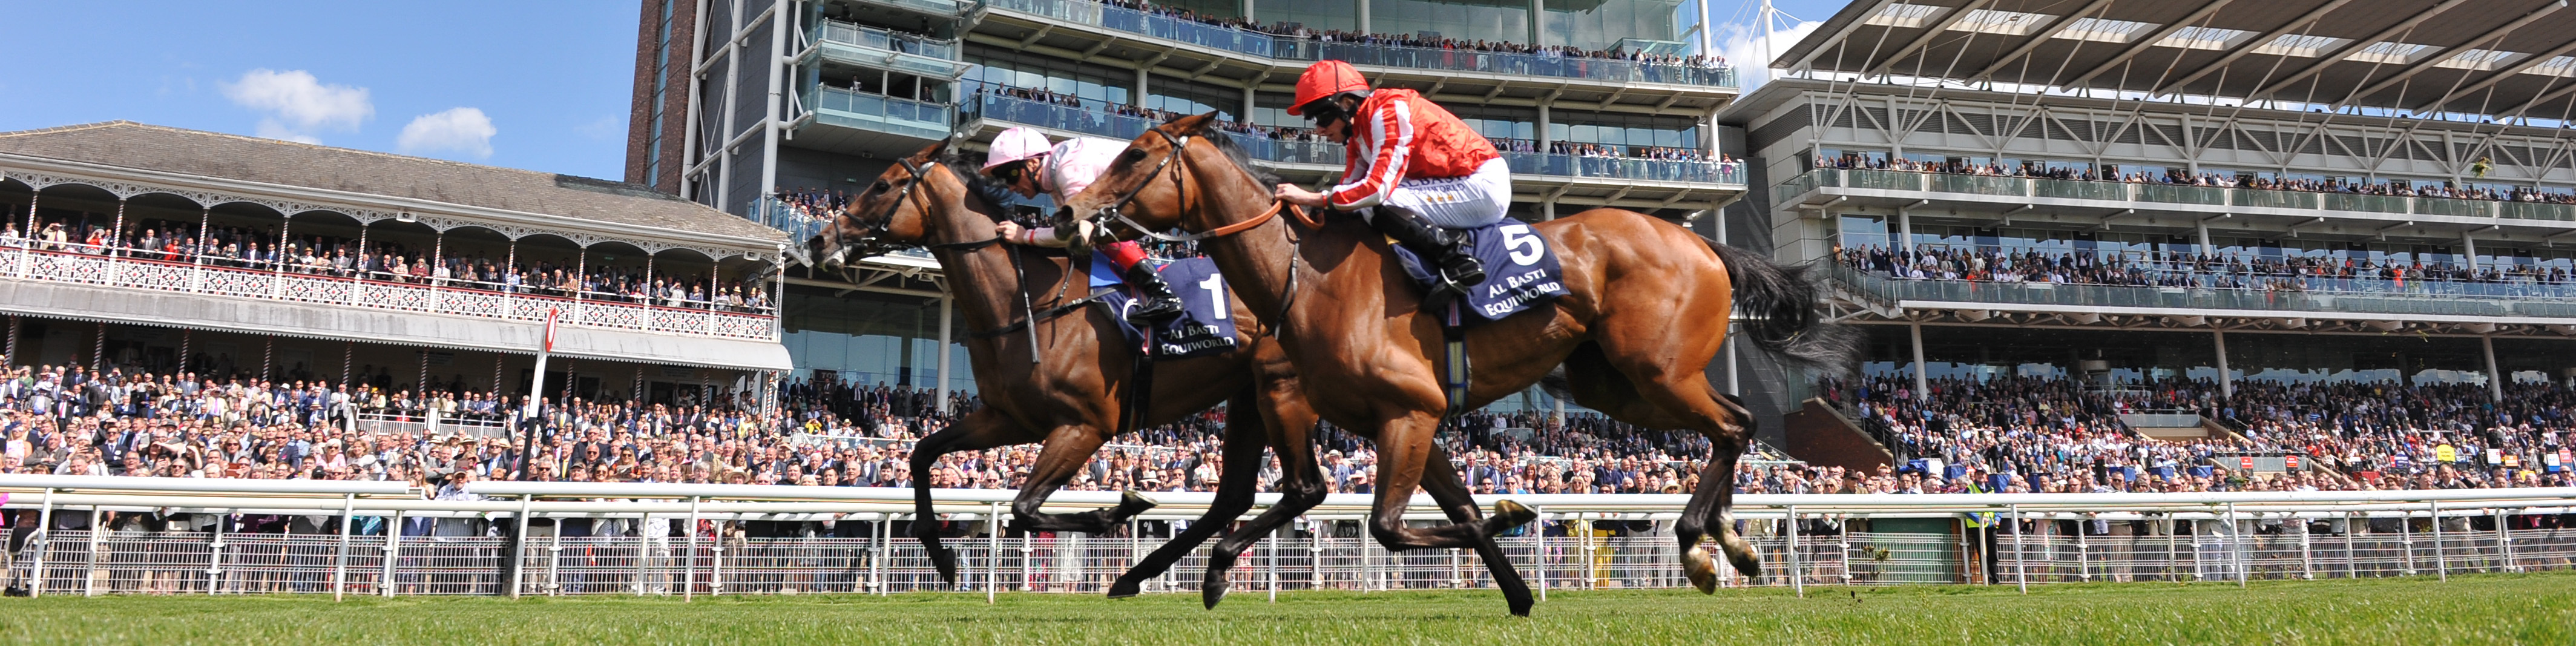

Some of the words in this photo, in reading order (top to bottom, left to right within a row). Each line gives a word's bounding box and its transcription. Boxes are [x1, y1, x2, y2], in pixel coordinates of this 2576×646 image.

[1419, 174, 1470, 185] BAS
[1499, 224, 1544, 266] 5
[1489, 283, 1508, 298] AL
[1506, 268, 1547, 289] BASTI
[1199, 273, 1227, 320] 1
[1484, 282, 1561, 316] EQUIWORLD
[1169, 329, 1184, 340] AL
[1188, 325, 1220, 337] BASTI
[1162, 336, 1235, 355] EQUIWORLD
[821, 371, 865, 381] TOTEOOL
